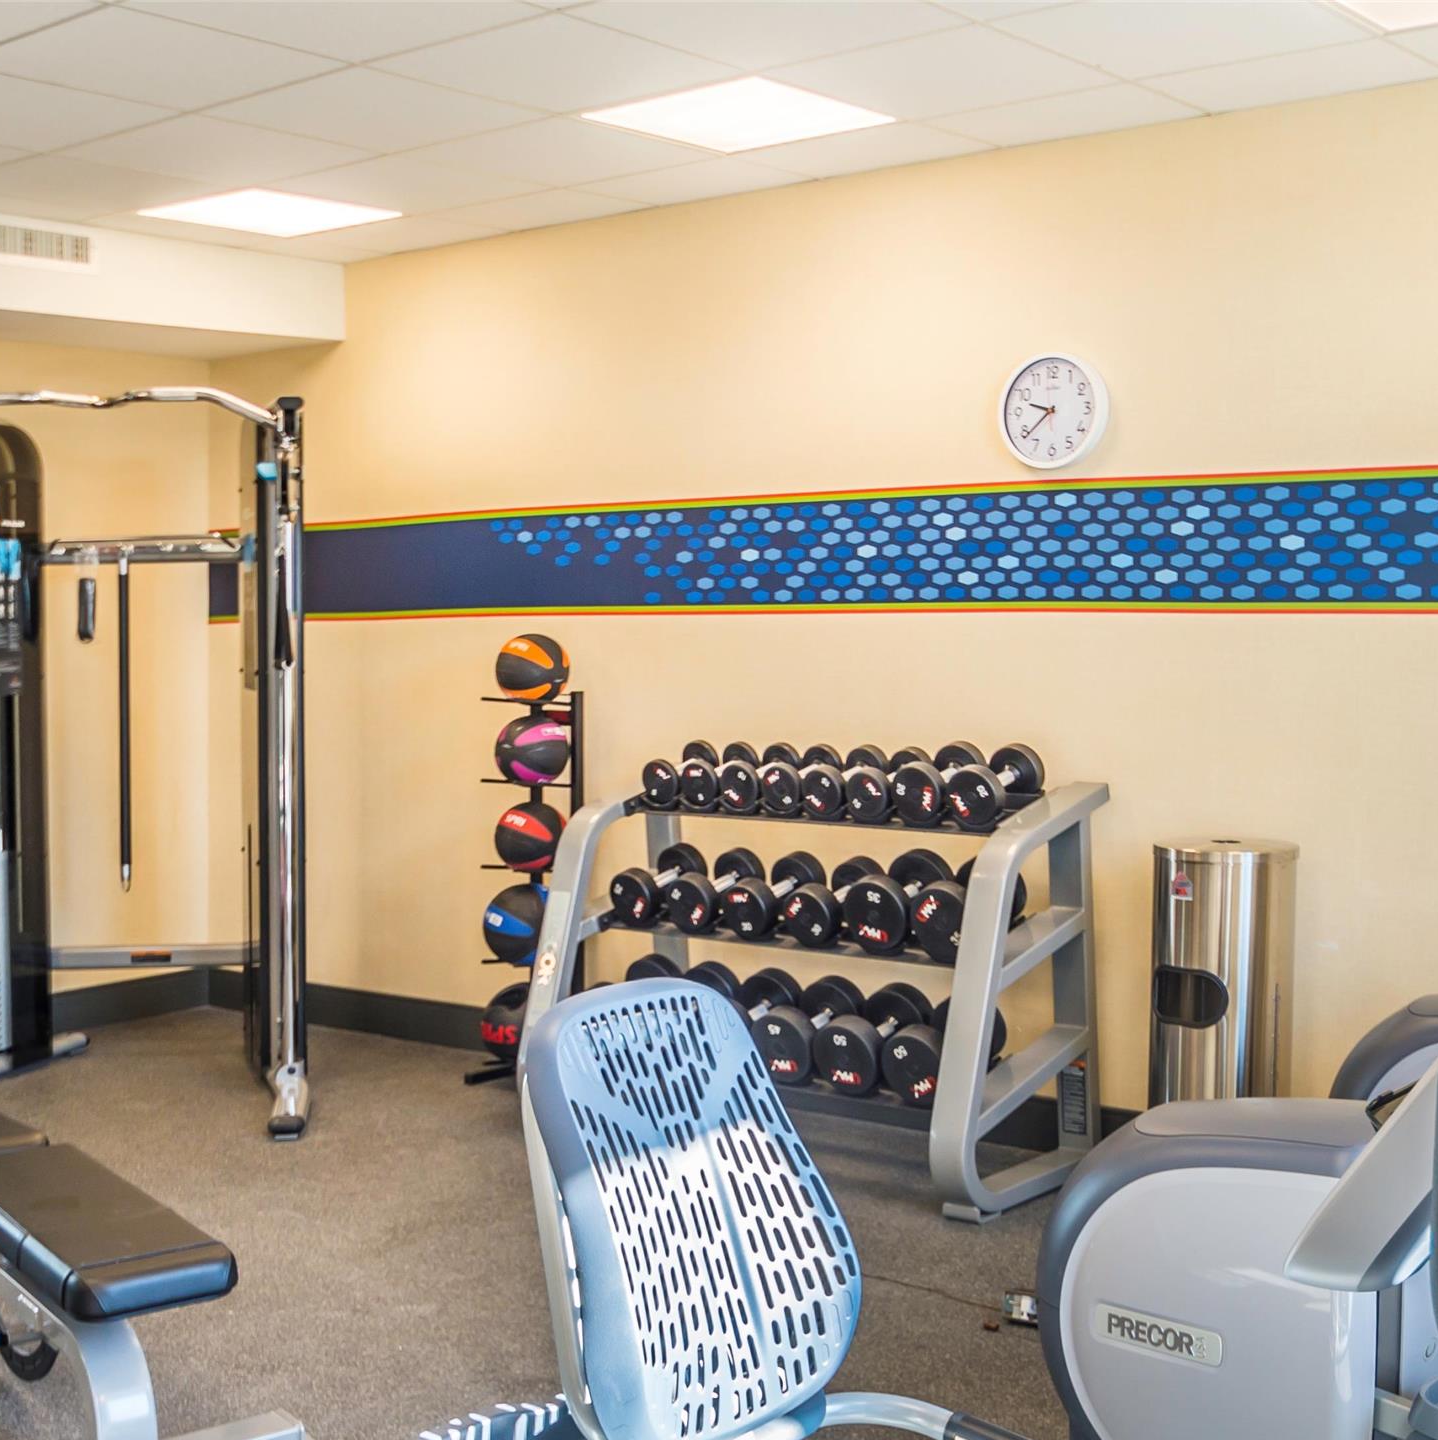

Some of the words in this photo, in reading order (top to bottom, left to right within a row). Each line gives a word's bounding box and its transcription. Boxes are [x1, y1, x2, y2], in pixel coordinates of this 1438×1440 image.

[1046, 365, 1059, 379] 12
[1068, 370, 1073, 384] 1
[1032, 373, 1041, 386] 11
[1015, 387, 1031, 402] 10
[1077, 382, 1086, 396] 2
[1014, 406, 1023, 420] 9
[1083, 401, 1091, 415] 3
[1020, 424, 1030, 439] 8
[1077, 420, 1086, 433] 4
[1032, 438, 1040, 452] 7
[1065, 435, 1073, 449] 5
[1047, 443, 1057, 457] 6
[866, 890, 882, 904] 35
[1107, 1313, 1194, 1357] PRECOR
